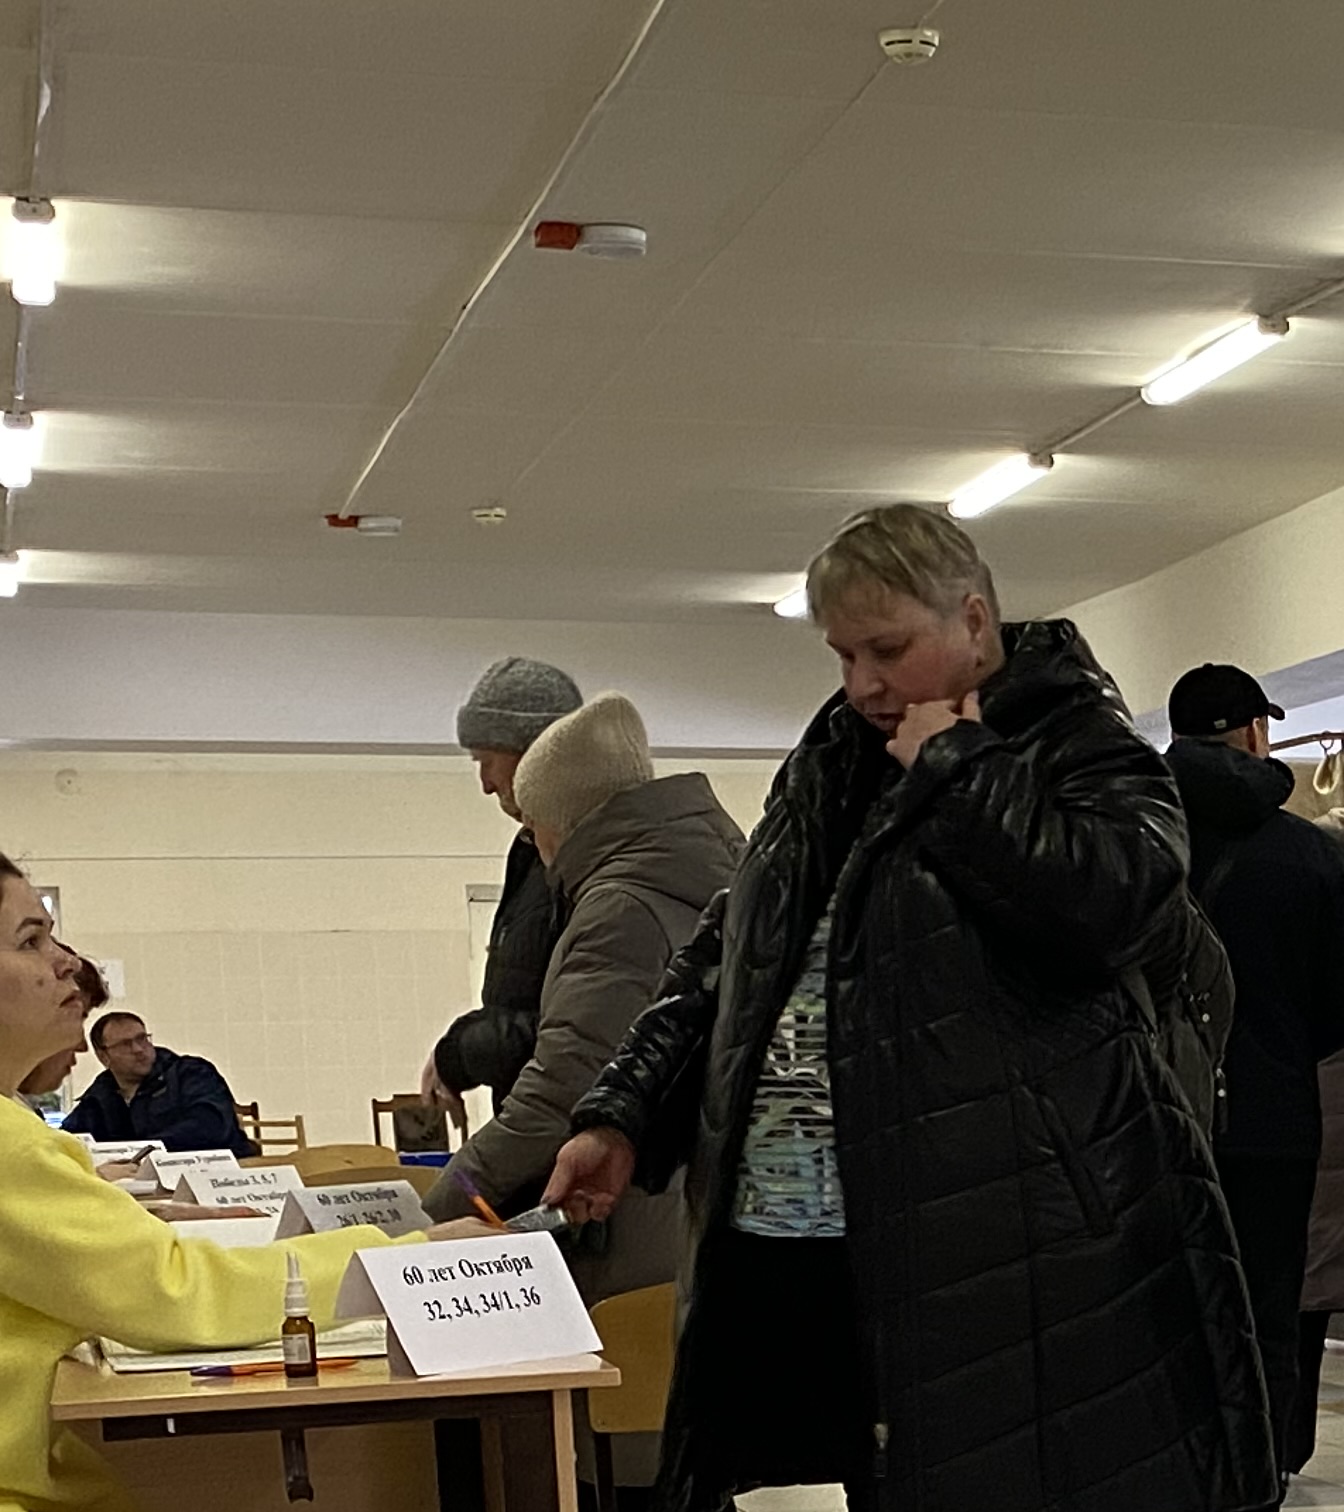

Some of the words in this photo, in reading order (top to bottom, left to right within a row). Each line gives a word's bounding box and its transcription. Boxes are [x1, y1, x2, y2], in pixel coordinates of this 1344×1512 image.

[247, 1191, 287, 1201] Октябр
[402, 1265, 425, 1286] 60
[428, 1266, 457, 1283] лет
[458, 1253, 534, 1279] Октября
[423, 1299, 453, 1323] 32,
[451, 1296, 481, 1318] 34,
[479, 1290, 521, 1313] 34/1,
[519, 1286, 541, 1308] 36
